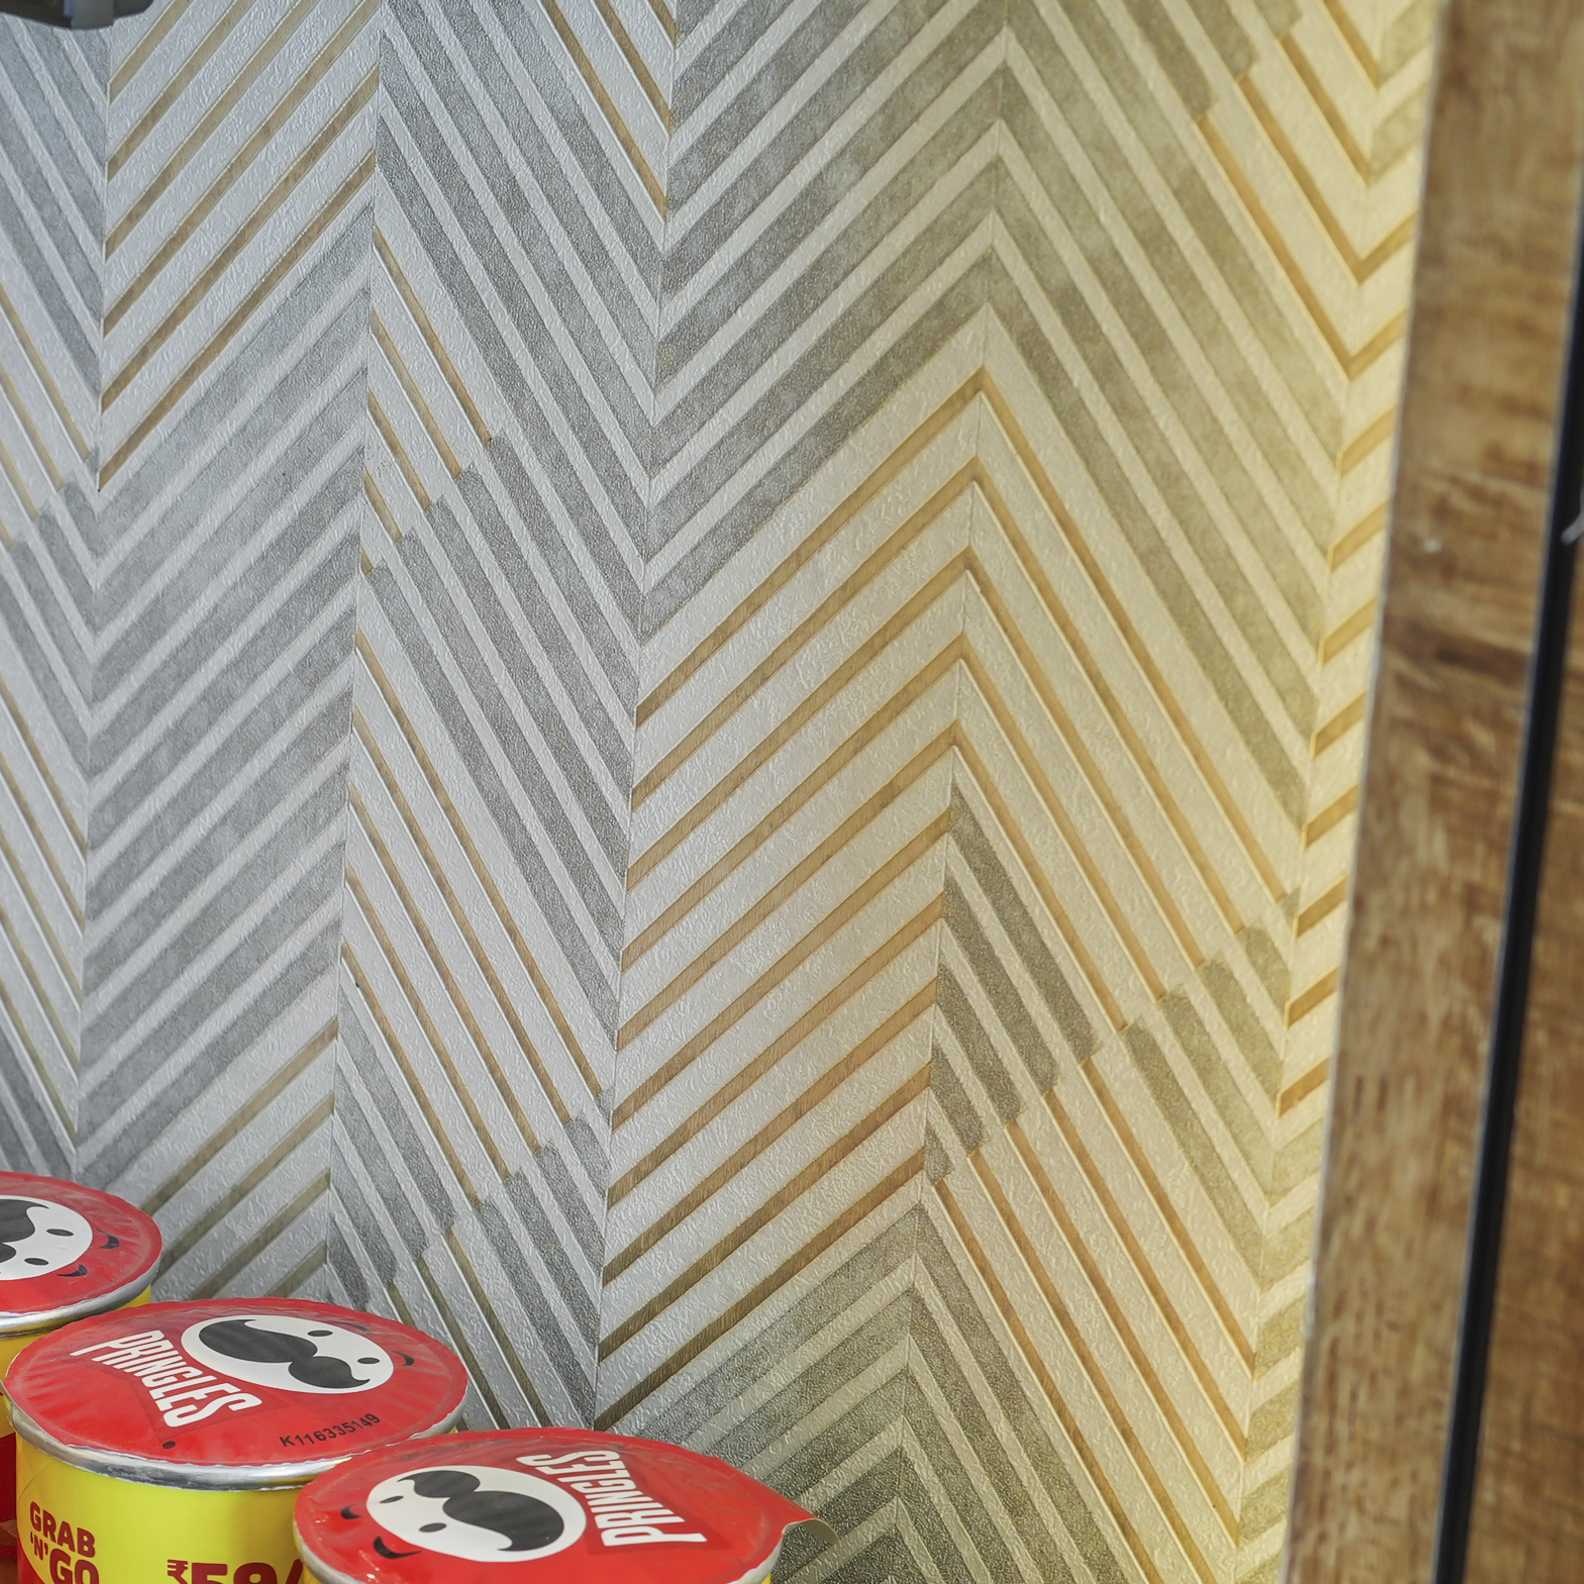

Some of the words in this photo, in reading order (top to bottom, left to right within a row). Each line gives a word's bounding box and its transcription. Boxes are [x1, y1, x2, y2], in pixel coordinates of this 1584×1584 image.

[70, 1329, 263, 1428] PRINGLES
[279, 1413, 382, 1450] K116335149
[28, 1500, 96, 1560] GRAB
[515, 1449, 708, 1547] PRINGLES
